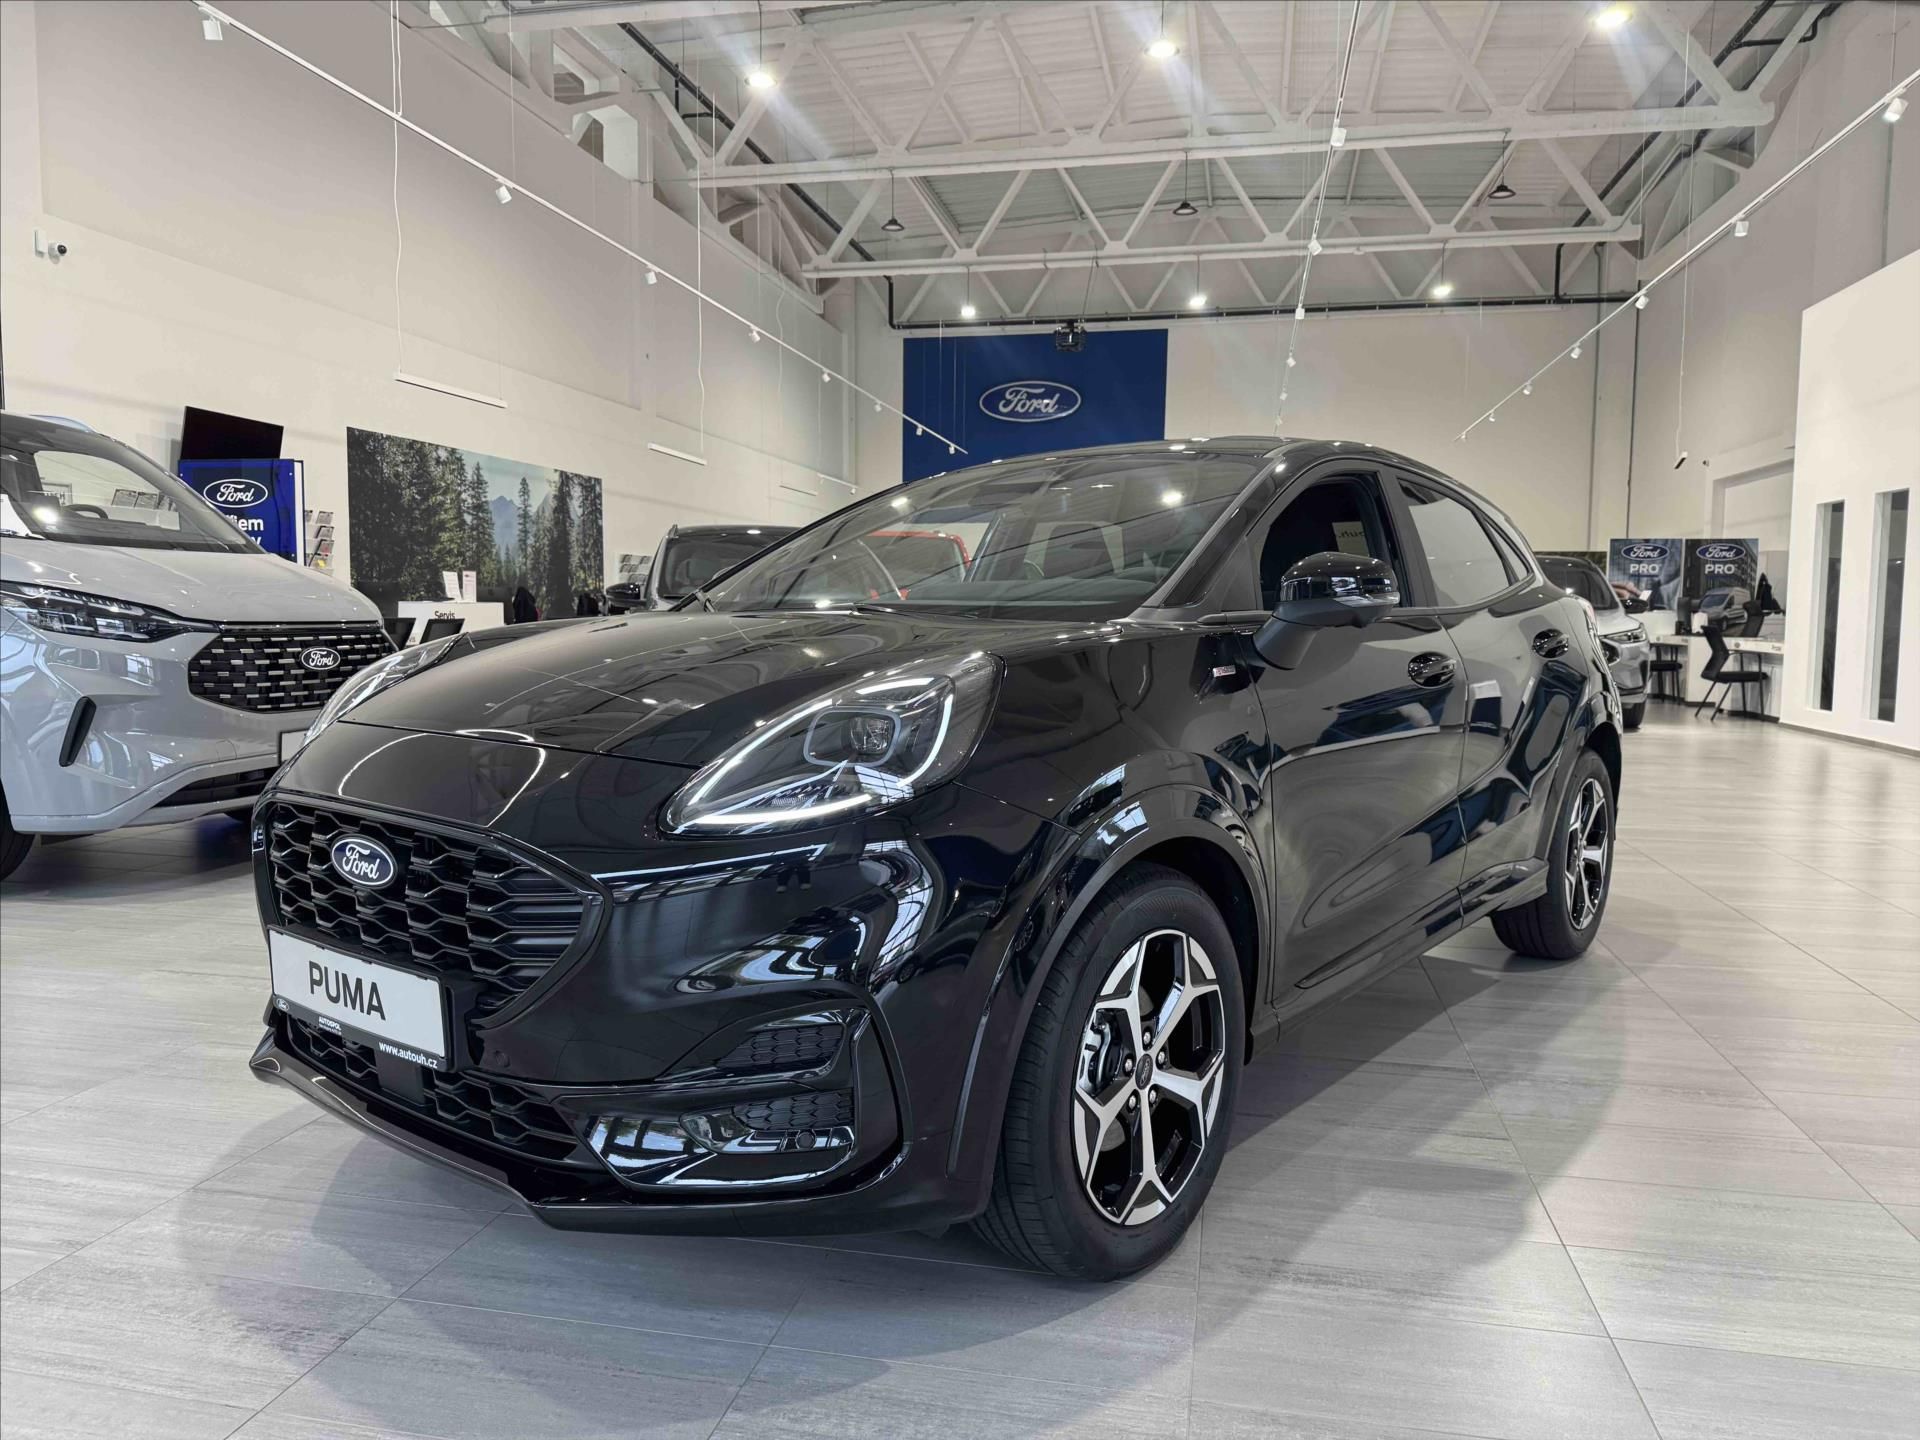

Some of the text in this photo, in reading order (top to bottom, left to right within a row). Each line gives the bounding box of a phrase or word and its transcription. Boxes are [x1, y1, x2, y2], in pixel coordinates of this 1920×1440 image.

[999, 387, 1059, 414] Ford
[216, 483, 255, 502] Ford
[1630, 546, 1660, 558] Ford
[1705, 546, 1736, 558] Ford
[1629, 563, 1660, 574] PRO
[1704, 563, 1735, 575] PRO
[434, 610, 456, 619] Servis
[309, 651, 334, 667] Ford
[343, 843, 379, 879] Ford
[308, 960, 386, 1021] PUMA
[378, 1041, 438, 1069] www.autouh.cz
